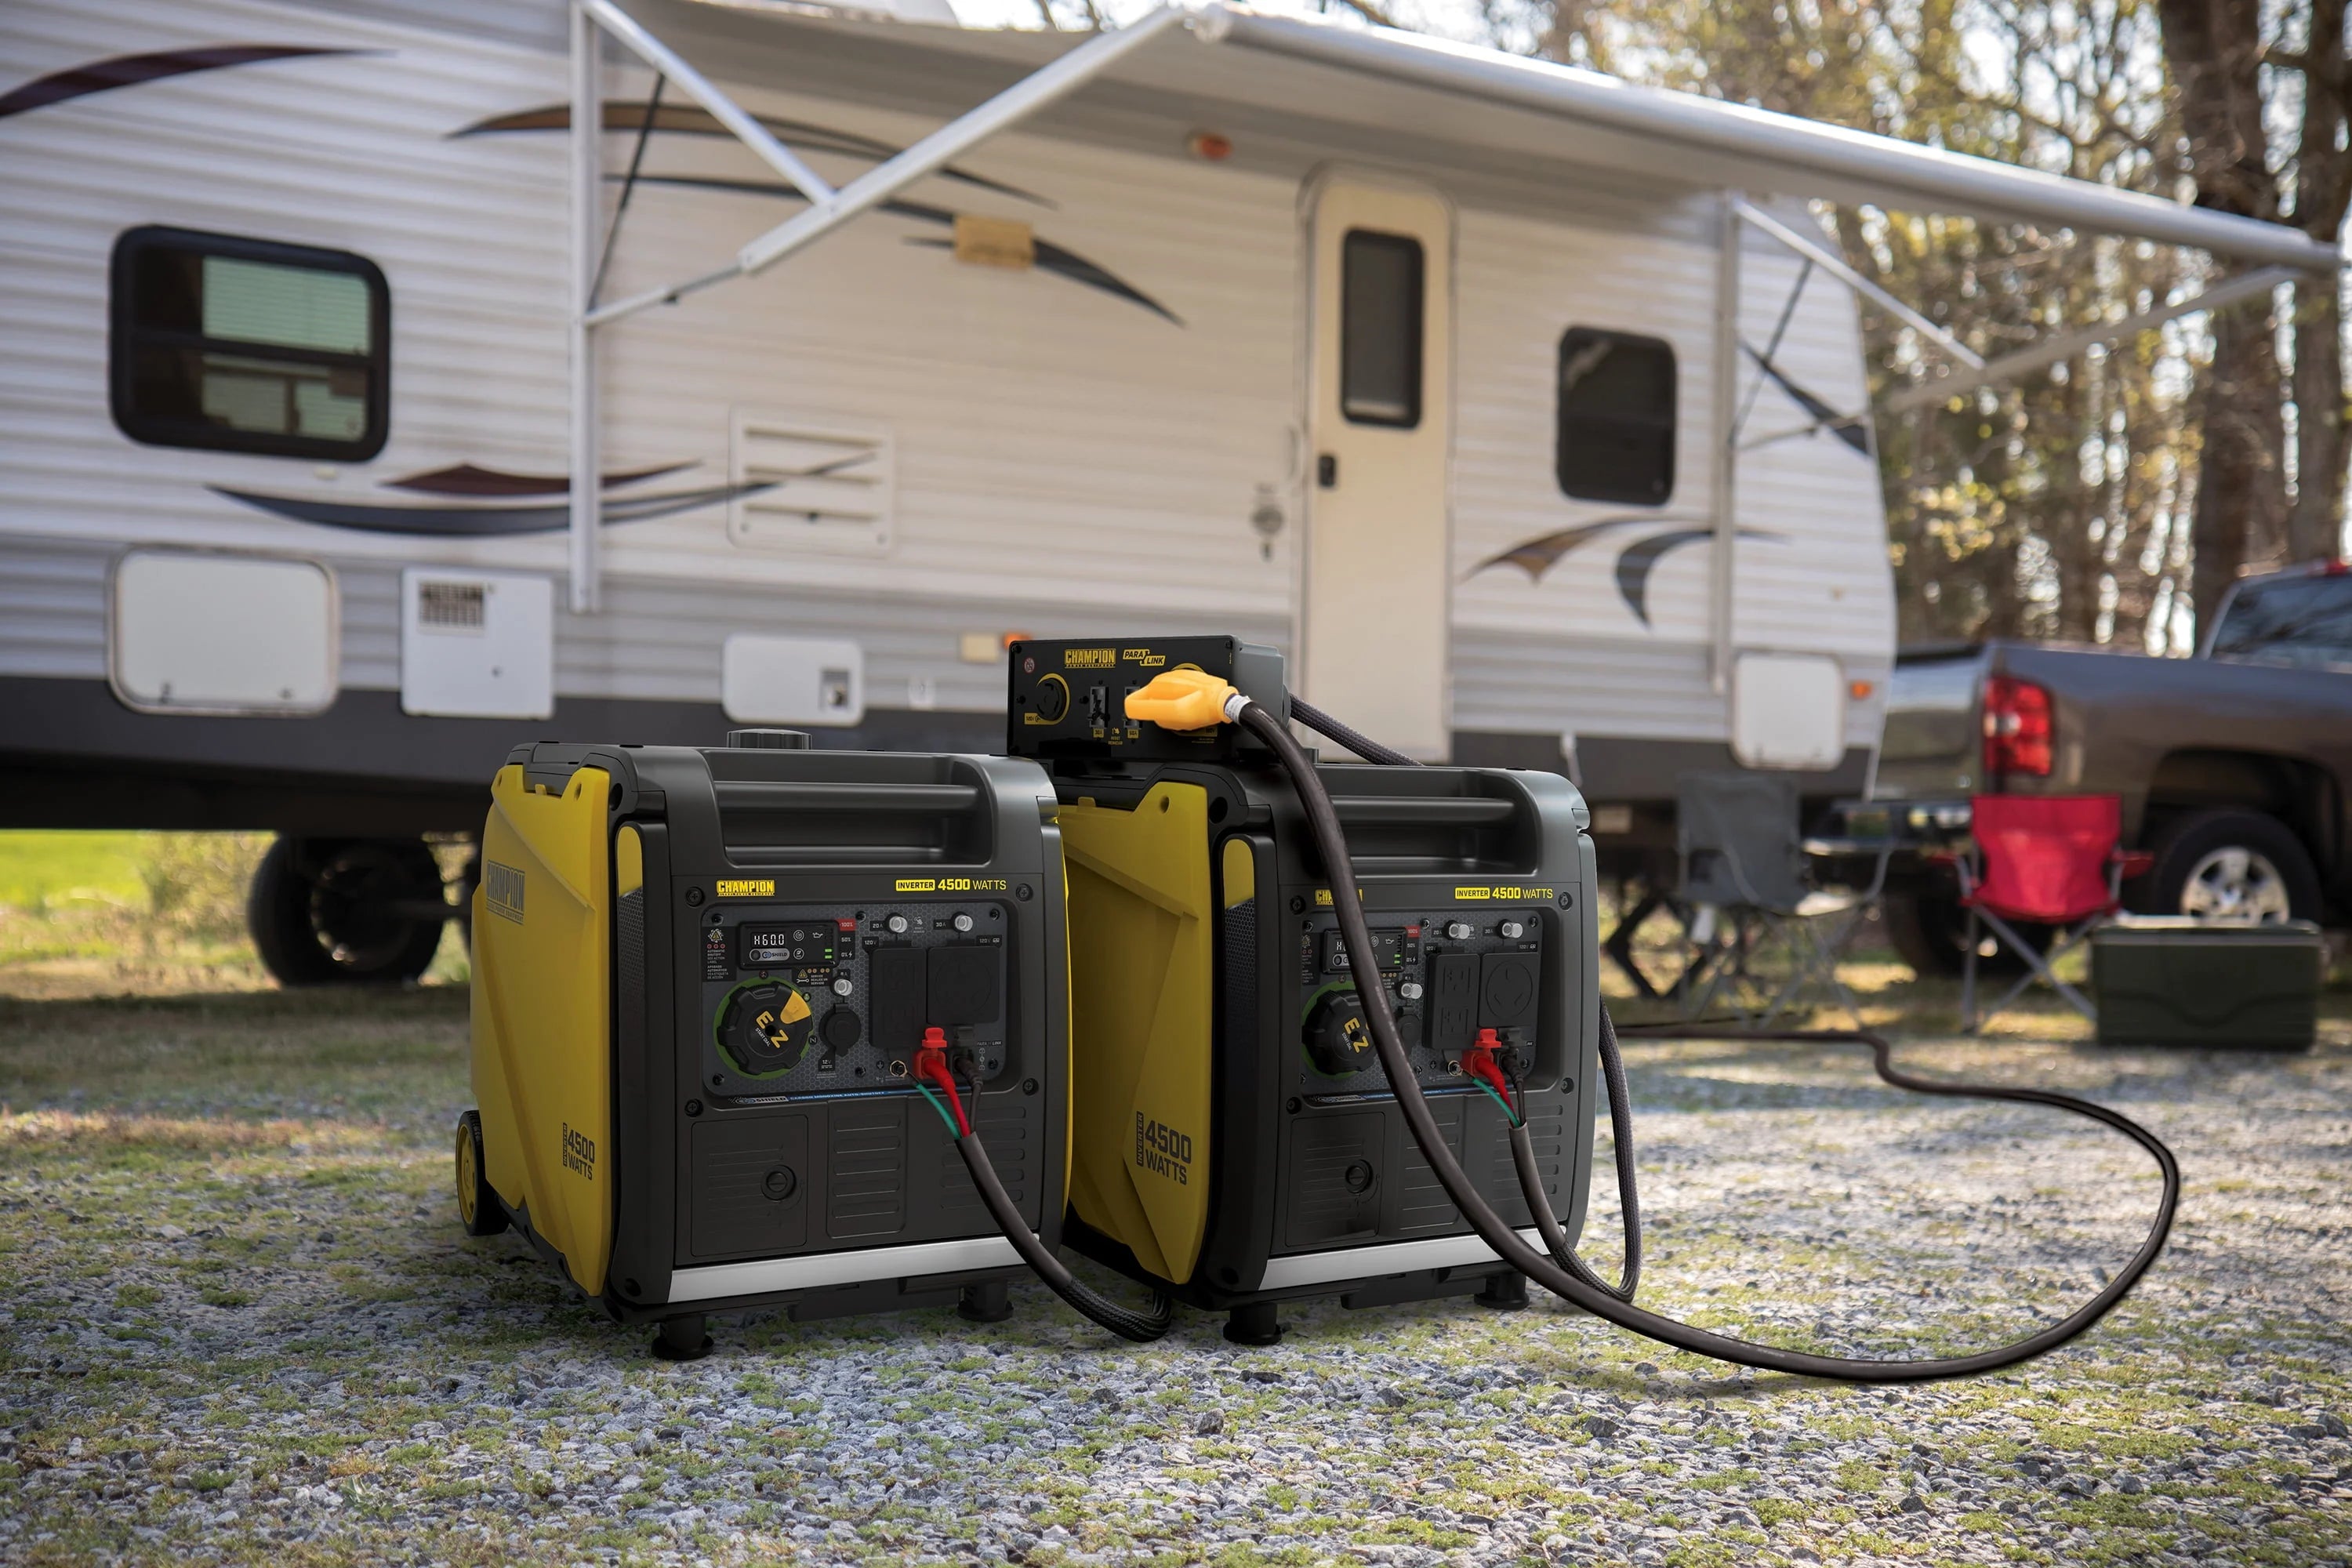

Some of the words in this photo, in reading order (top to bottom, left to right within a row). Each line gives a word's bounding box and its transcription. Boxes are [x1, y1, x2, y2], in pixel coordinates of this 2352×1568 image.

[1065, 649, 1115, 664] CHAMPION
[487, 862, 524, 912] CHAMPION
[717, 880, 774, 892] CHAMPION
[938, 878, 971, 891] 4500
[972, 880, 1007, 890] WATTS
[1491, 887, 1521, 899] 4500
[1523, 888, 1553, 899] WATTS
[755, 1027, 766, 1039] START
[568, 1129, 595, 1163] 4500
[1145, 1120, 1191, 1164] 4500
[568, 1152, 593, 1181] WATTS
[1145, 1149, 1187, 1185] WATTS
